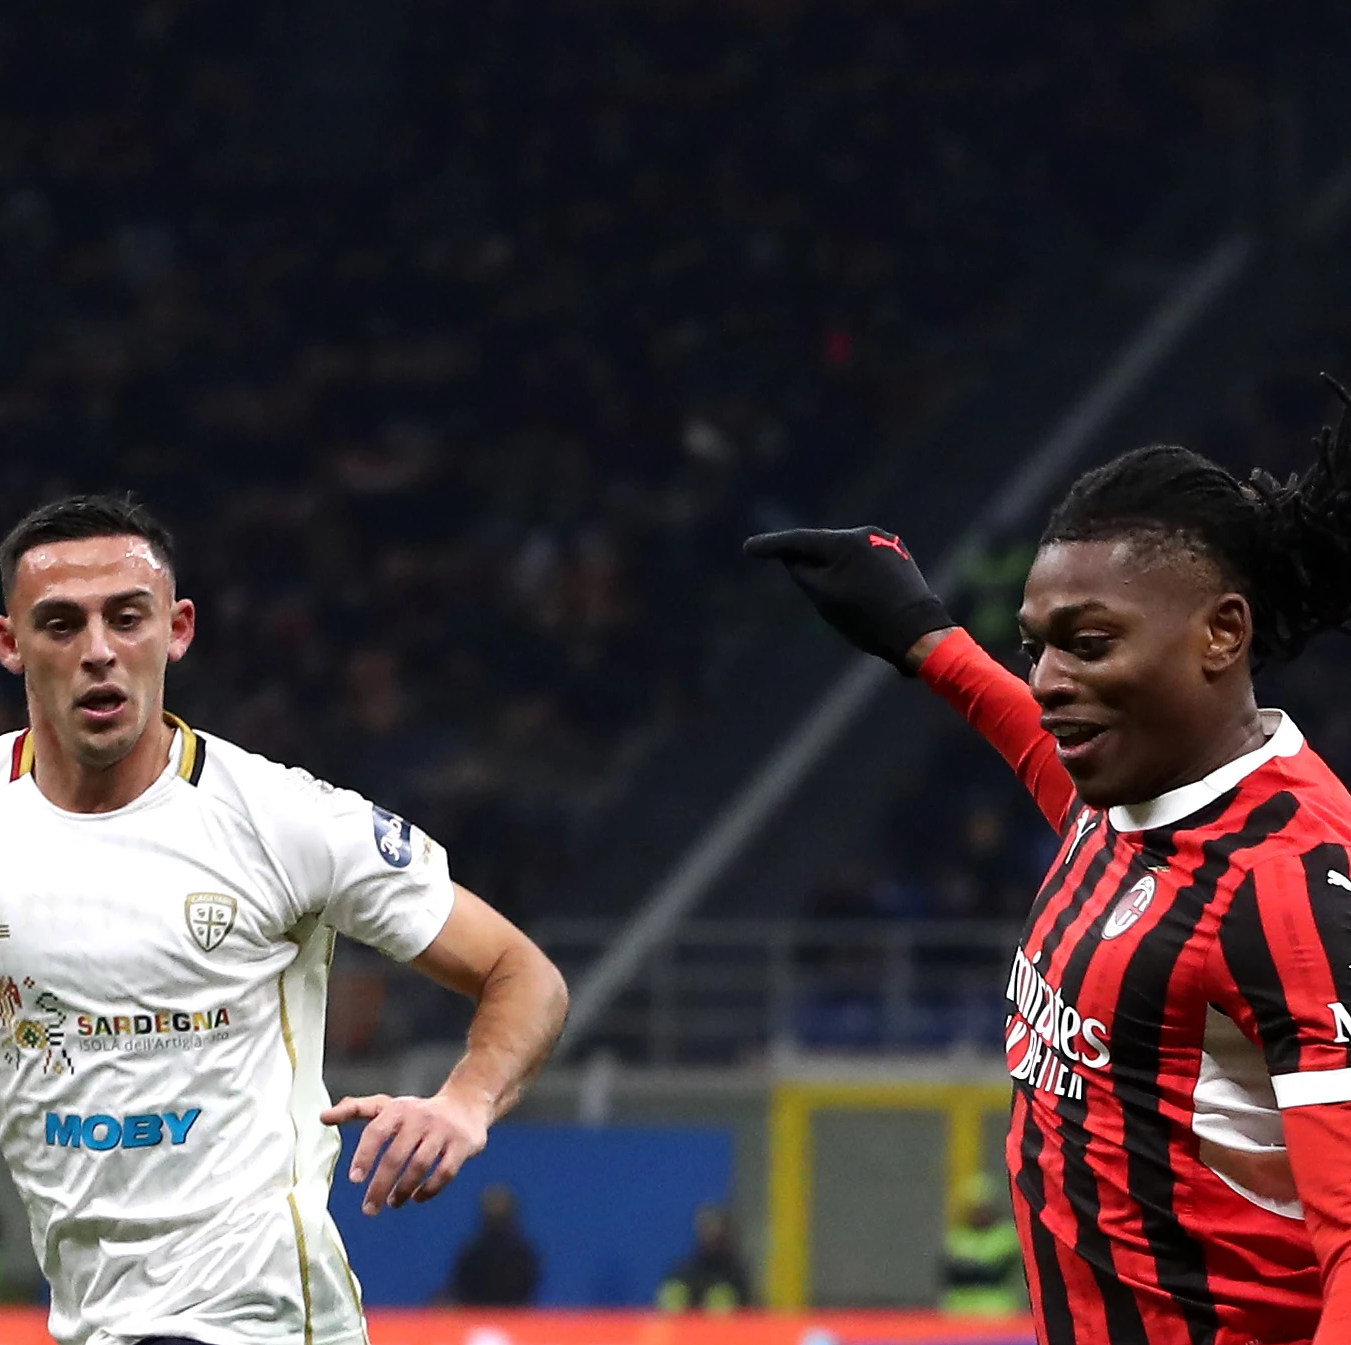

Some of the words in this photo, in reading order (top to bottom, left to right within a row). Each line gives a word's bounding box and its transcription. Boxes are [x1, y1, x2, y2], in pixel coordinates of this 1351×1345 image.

[77, 1008, 231, 1036] SARDEGNA
[1006, 946, 1111, 1069] mirates
[45, 1108, 202, 1150] MOBY
